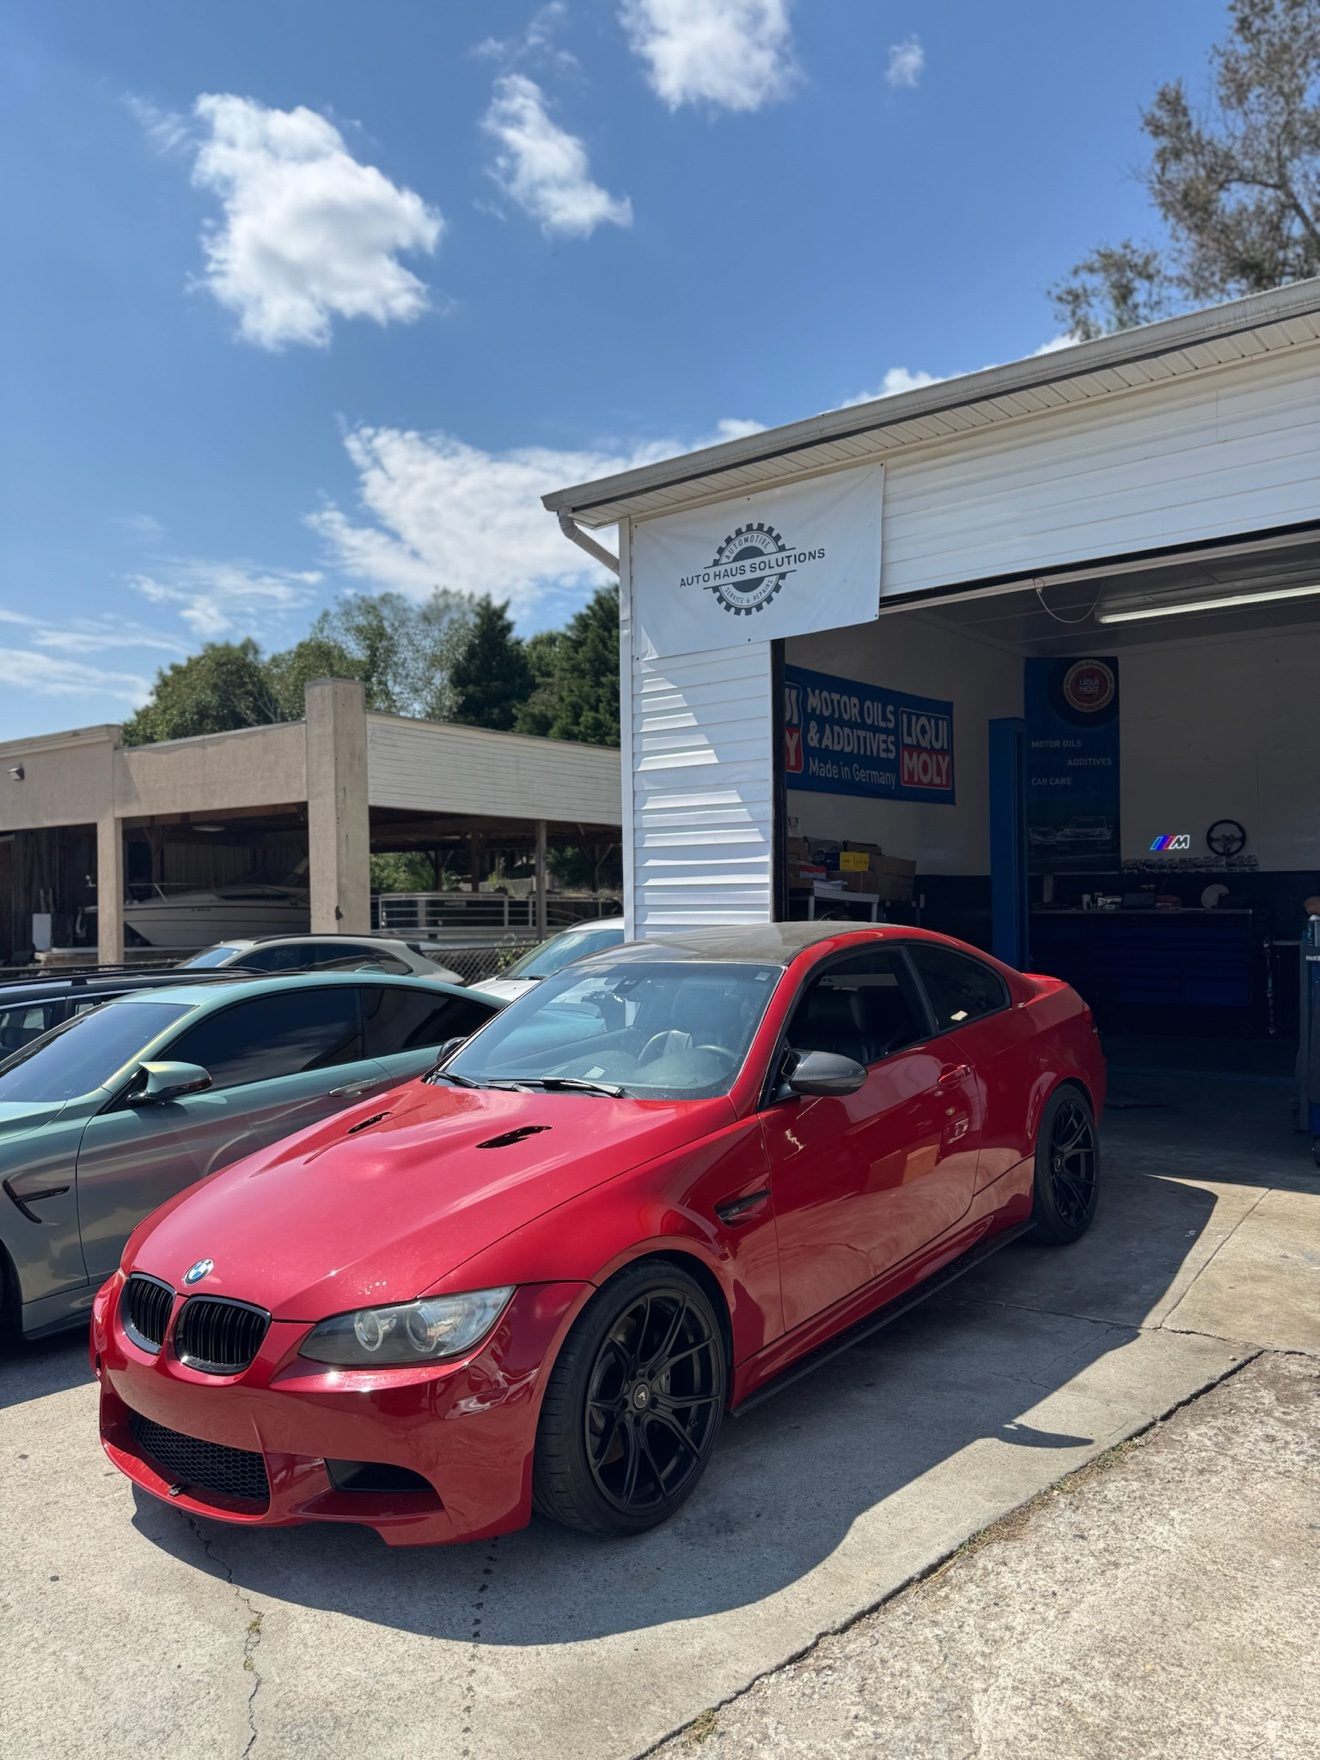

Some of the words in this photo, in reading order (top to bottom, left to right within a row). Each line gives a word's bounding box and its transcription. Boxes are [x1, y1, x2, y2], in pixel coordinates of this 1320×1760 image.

[725, 534, 771, 560] AUTOMOTIVE
[680, 572, 710, 588] AUTO
[713, 565, 746, 581] HAUS
[749, 548, 826, 573] SOLUTIONS
[724, 586, 744, 604] SERVICE
[753, 579, 774, 602] REPAIRS
[807, 687, 861, 723] MOTOR
[863, 700, 895, 729] OILS
[807, 720, 820, 747] &
[822, 724, 896, 760] ADDITIVES
[902, 713, 948, 750] LIQUI
[1031, 740, 1060, 748] MOTOR
[1062, 739, 1082, 748] OILS
[808, 757, 839, 779] Made
[841, 762, 851, 780] in
[852, 765, 896, 790] Germany
[903, 751, 949, 785] MOLY
[1067, 757, 1112, 766] ADDITIVES
[1031, 777, 1048, 786] CAR
[1049, 776, 1072, 785] CARE
